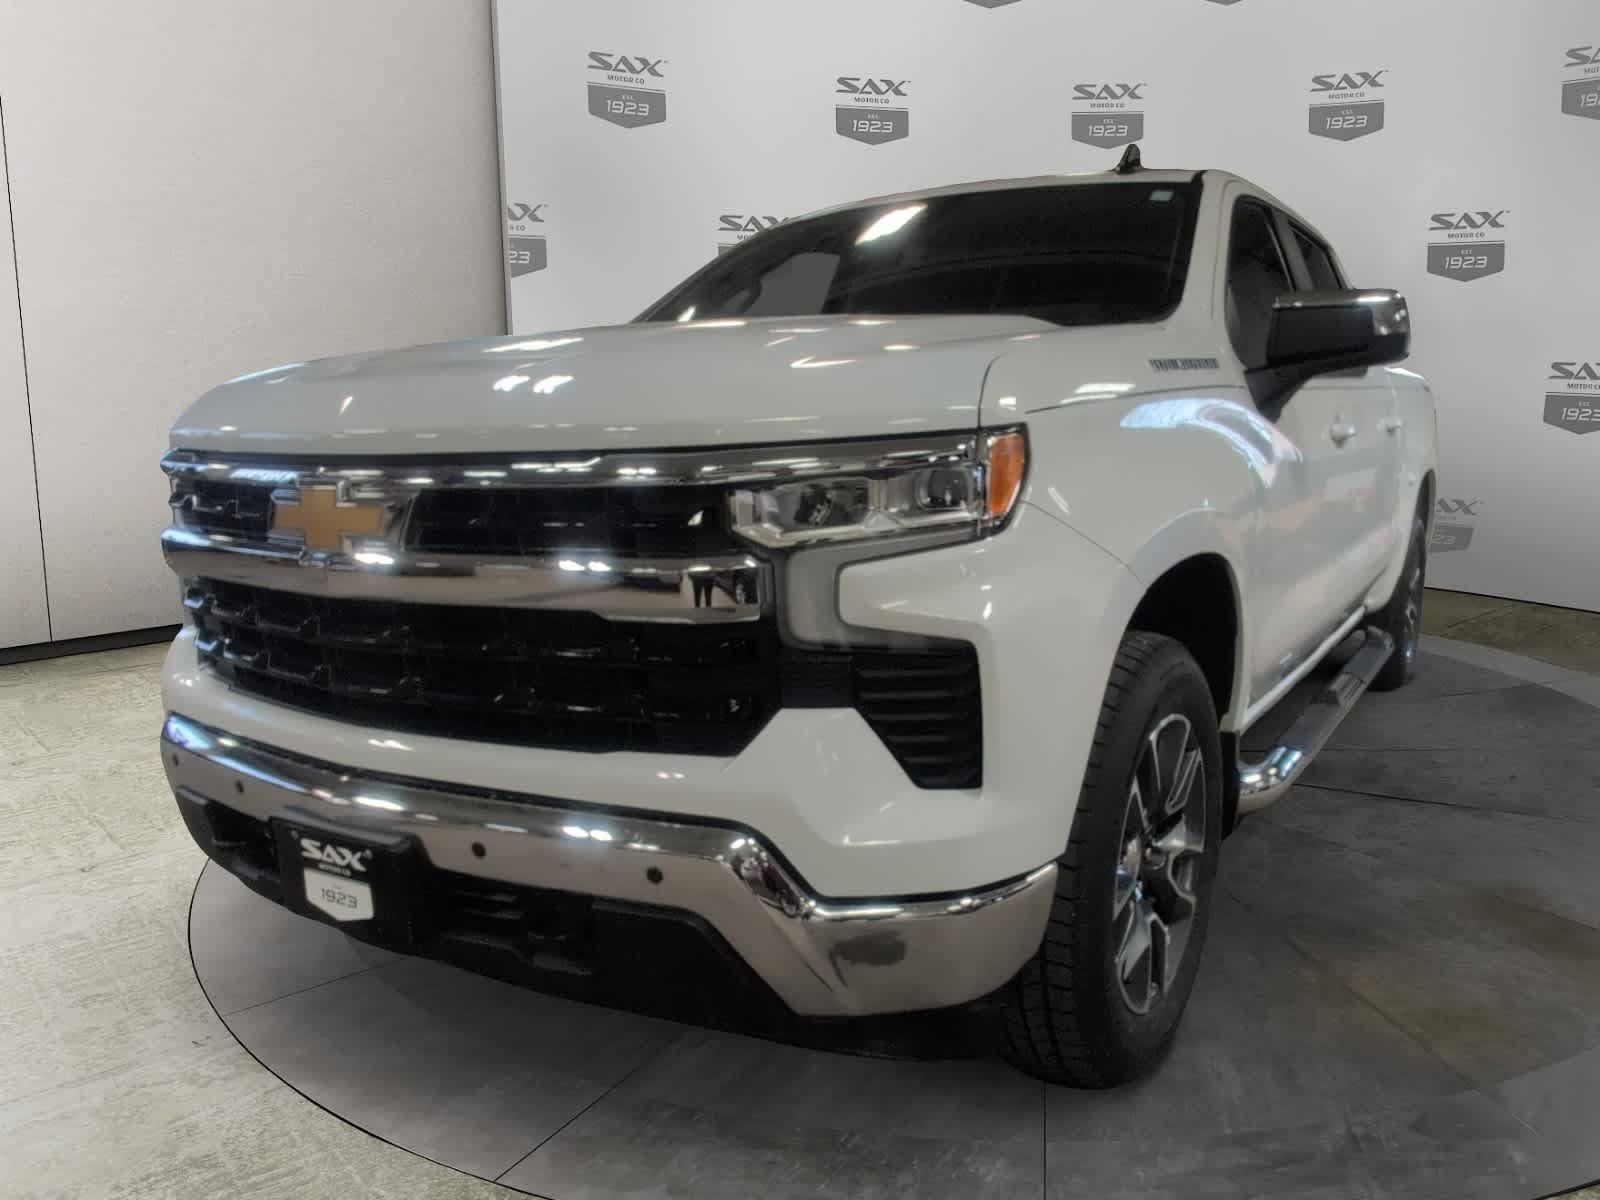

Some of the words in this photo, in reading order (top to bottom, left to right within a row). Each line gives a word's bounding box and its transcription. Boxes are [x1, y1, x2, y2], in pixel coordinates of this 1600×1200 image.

[588, 51, 664, 77] SAX
[836, 77, 908, 96] SAX
[1310, 70, 1384, 92] SAX
[1072, 84, 1144, 100] SAX
[607, 100, 650, 116] 1923
[852, 119, 893, 133] 1923
[1088, 125, 1128, 137] 1923
[1326, 115, 1368, 129] 1923
[1429, 210, 1504, 231] SAX
[1445, 256, 1488, 270] 1923
[1549, 362, 1600, 380] SA
[301, 838, 367, 872] SAX
[321, 888, 358, 909] 1923
